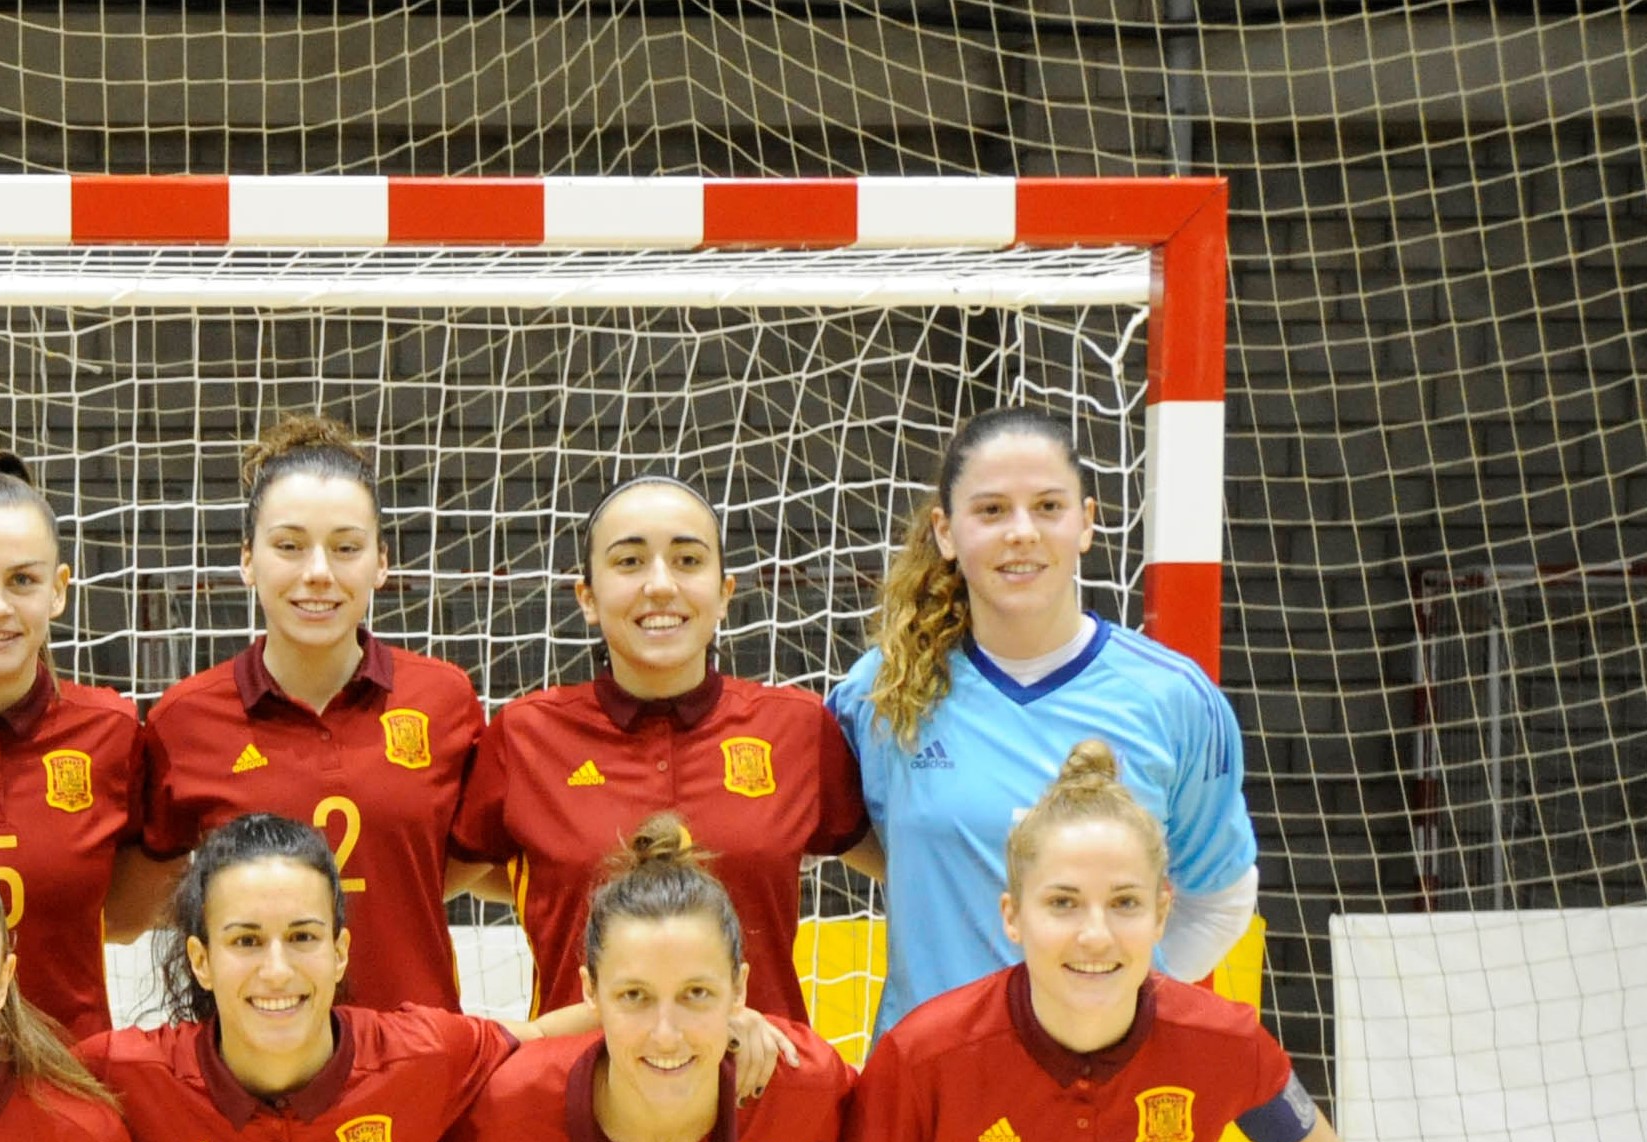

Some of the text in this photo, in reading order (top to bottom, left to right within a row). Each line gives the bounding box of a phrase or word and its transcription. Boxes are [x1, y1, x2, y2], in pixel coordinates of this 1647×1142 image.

[232, 757, 268, 773] adidas
[910, 760, 955, 770] adidas
[566, 775, 605, 786] adidas
[313, 796, 365, 893] 2
